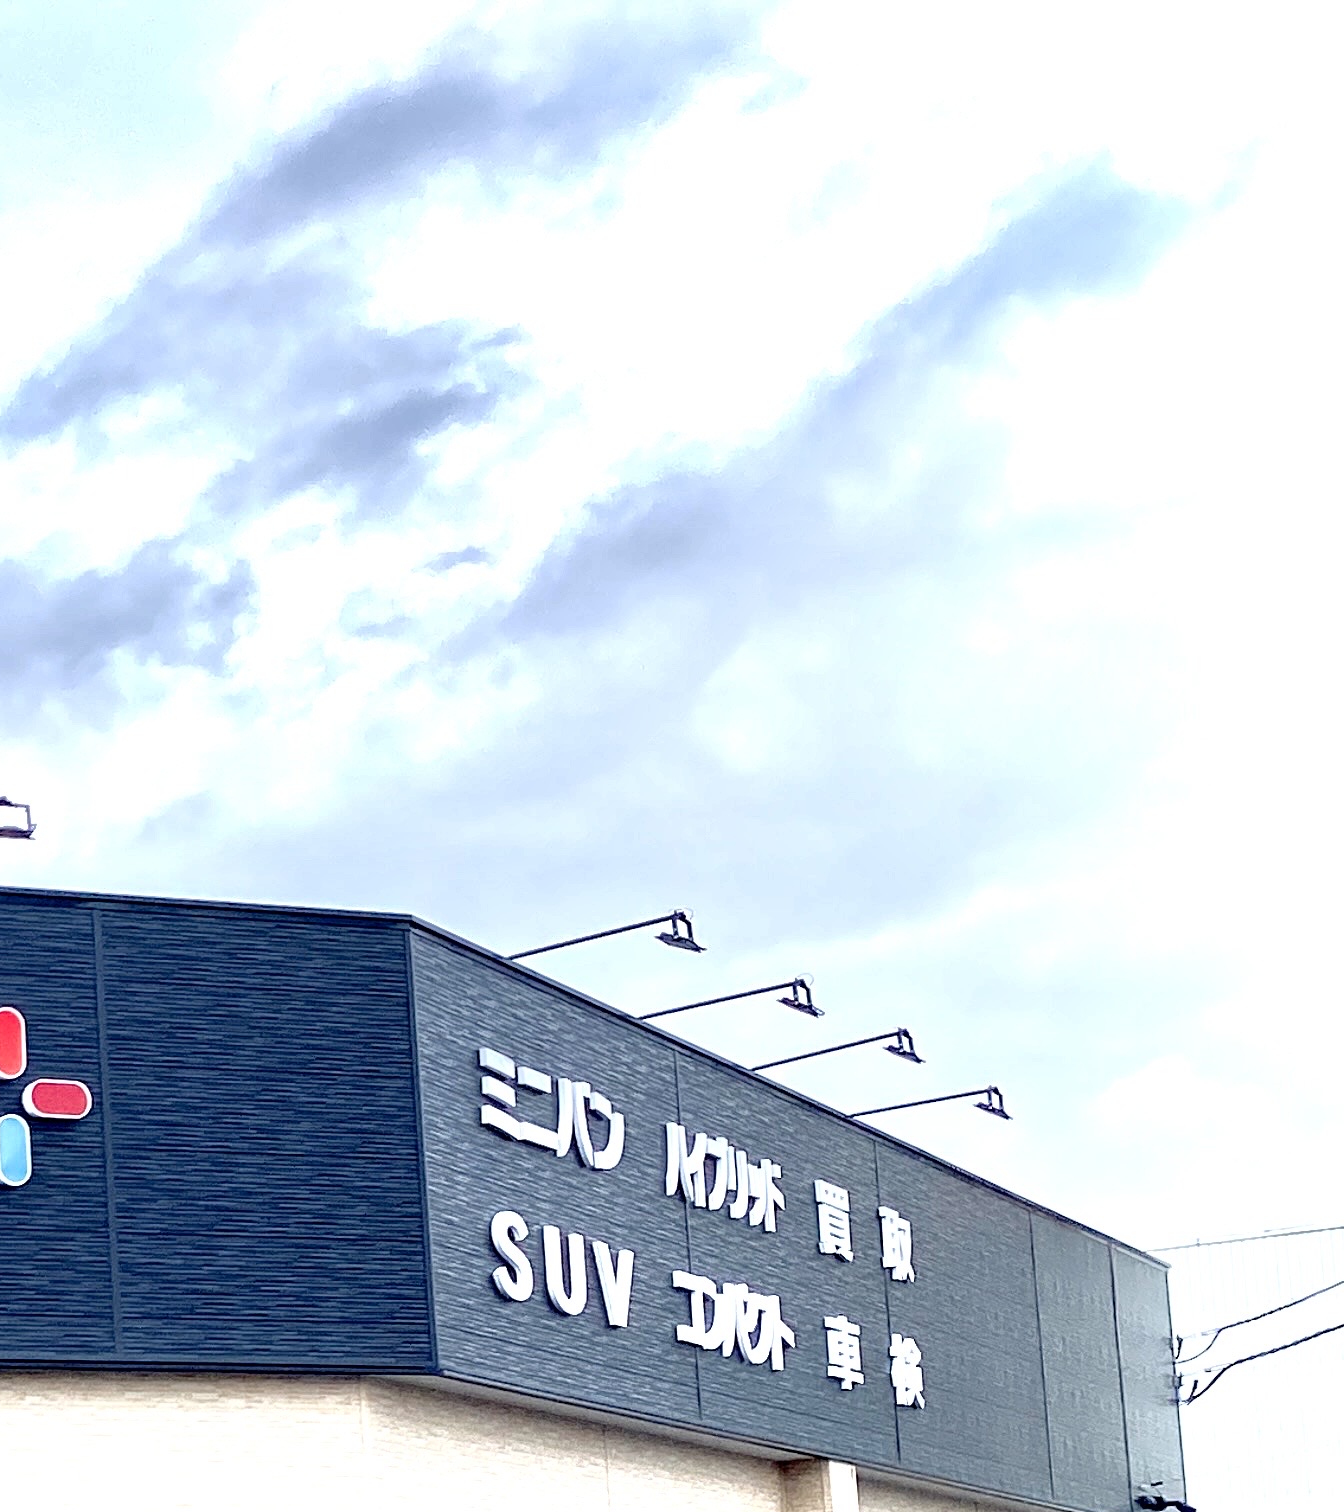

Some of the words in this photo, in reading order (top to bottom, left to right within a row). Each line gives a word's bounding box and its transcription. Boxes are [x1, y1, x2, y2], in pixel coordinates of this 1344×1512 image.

[479, 1047, 625, 1170] ミニバン
[490, 1211, 634, 1328] SUV
[672, 1270, 796, 1371] コンパクト
